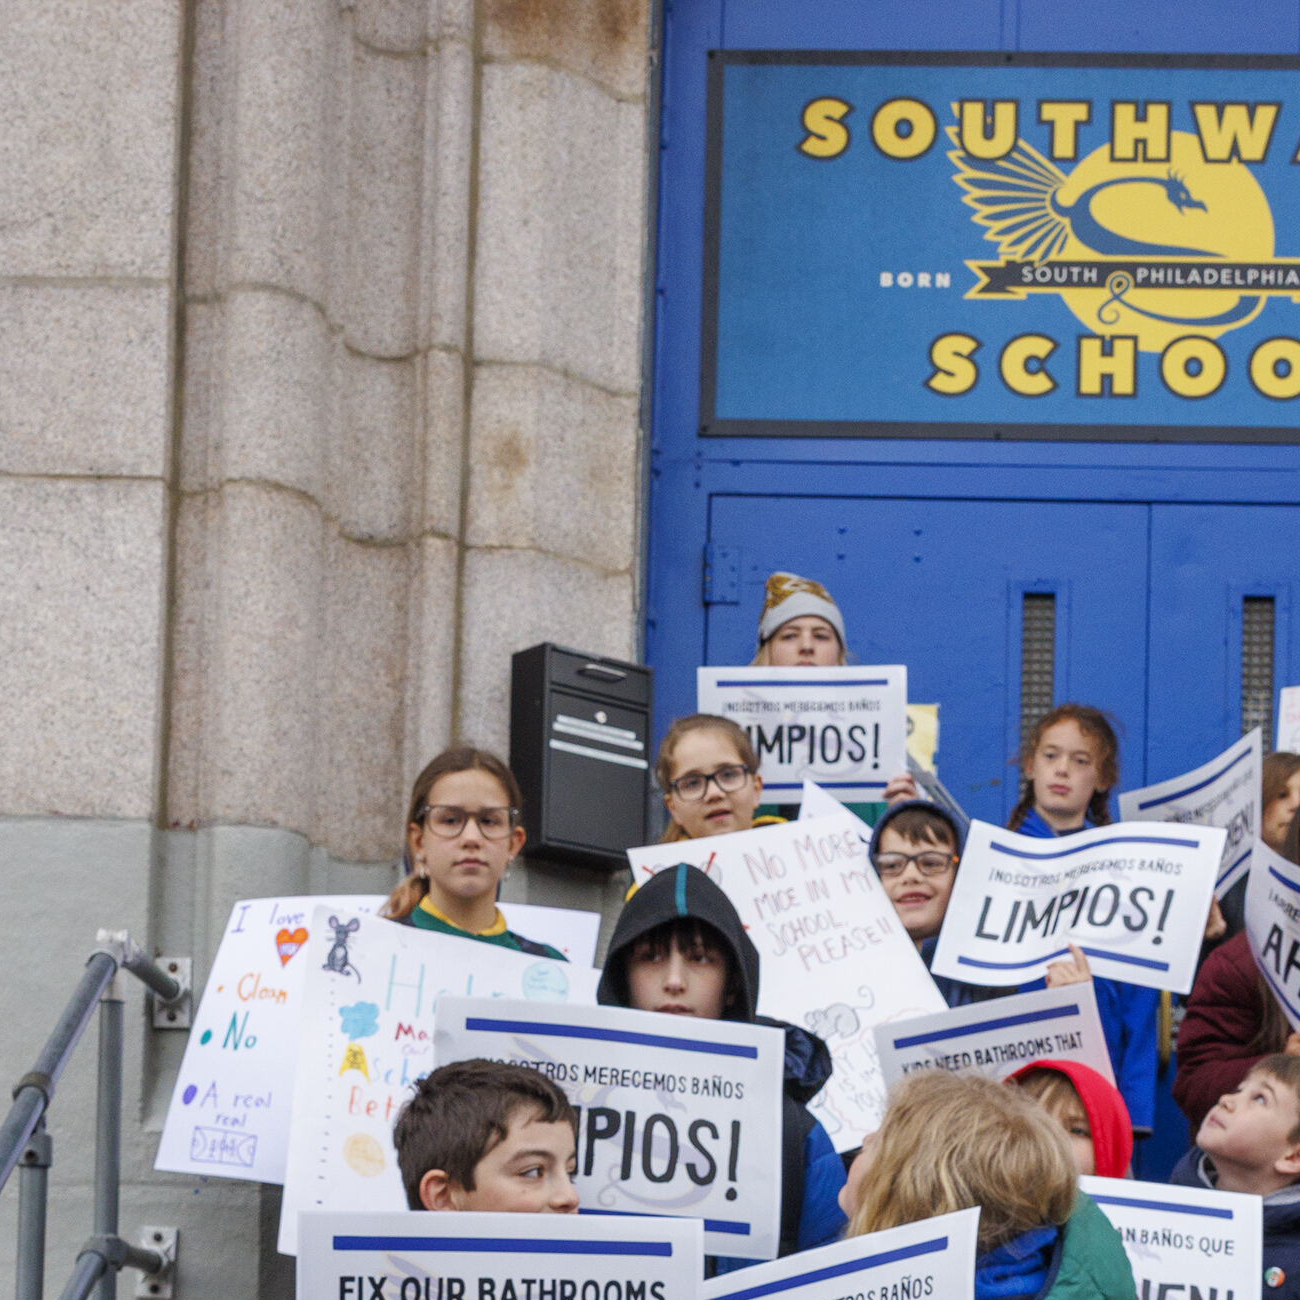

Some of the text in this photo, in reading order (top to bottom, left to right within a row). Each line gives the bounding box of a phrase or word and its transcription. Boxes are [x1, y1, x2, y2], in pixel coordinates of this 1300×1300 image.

[880, 272, 952, 288] BORN
[1022, 266, 1300, 288] SOUTH PHILADELPHIA
[1137, 857, 1183, 876] BAÑOS
[231, 903, 305, 933] I love
[975, 884, 1174, 946] LIMPIOS!
[223, 1011, 257, 1050] No
[975, 1037, 1054, 1066] BATHROOMS
[1054, 1031, 1084, 1050] THAT
[200, 1081, 218, 1108] A
[583, 1066, 687, 1094] MERECEMOS
[691, 1075, 744, 1099] BAÑOS
[1141, 1227, 1194, 1250] BAÑOS
[1200, 1236, 1235, 1257] QUE
